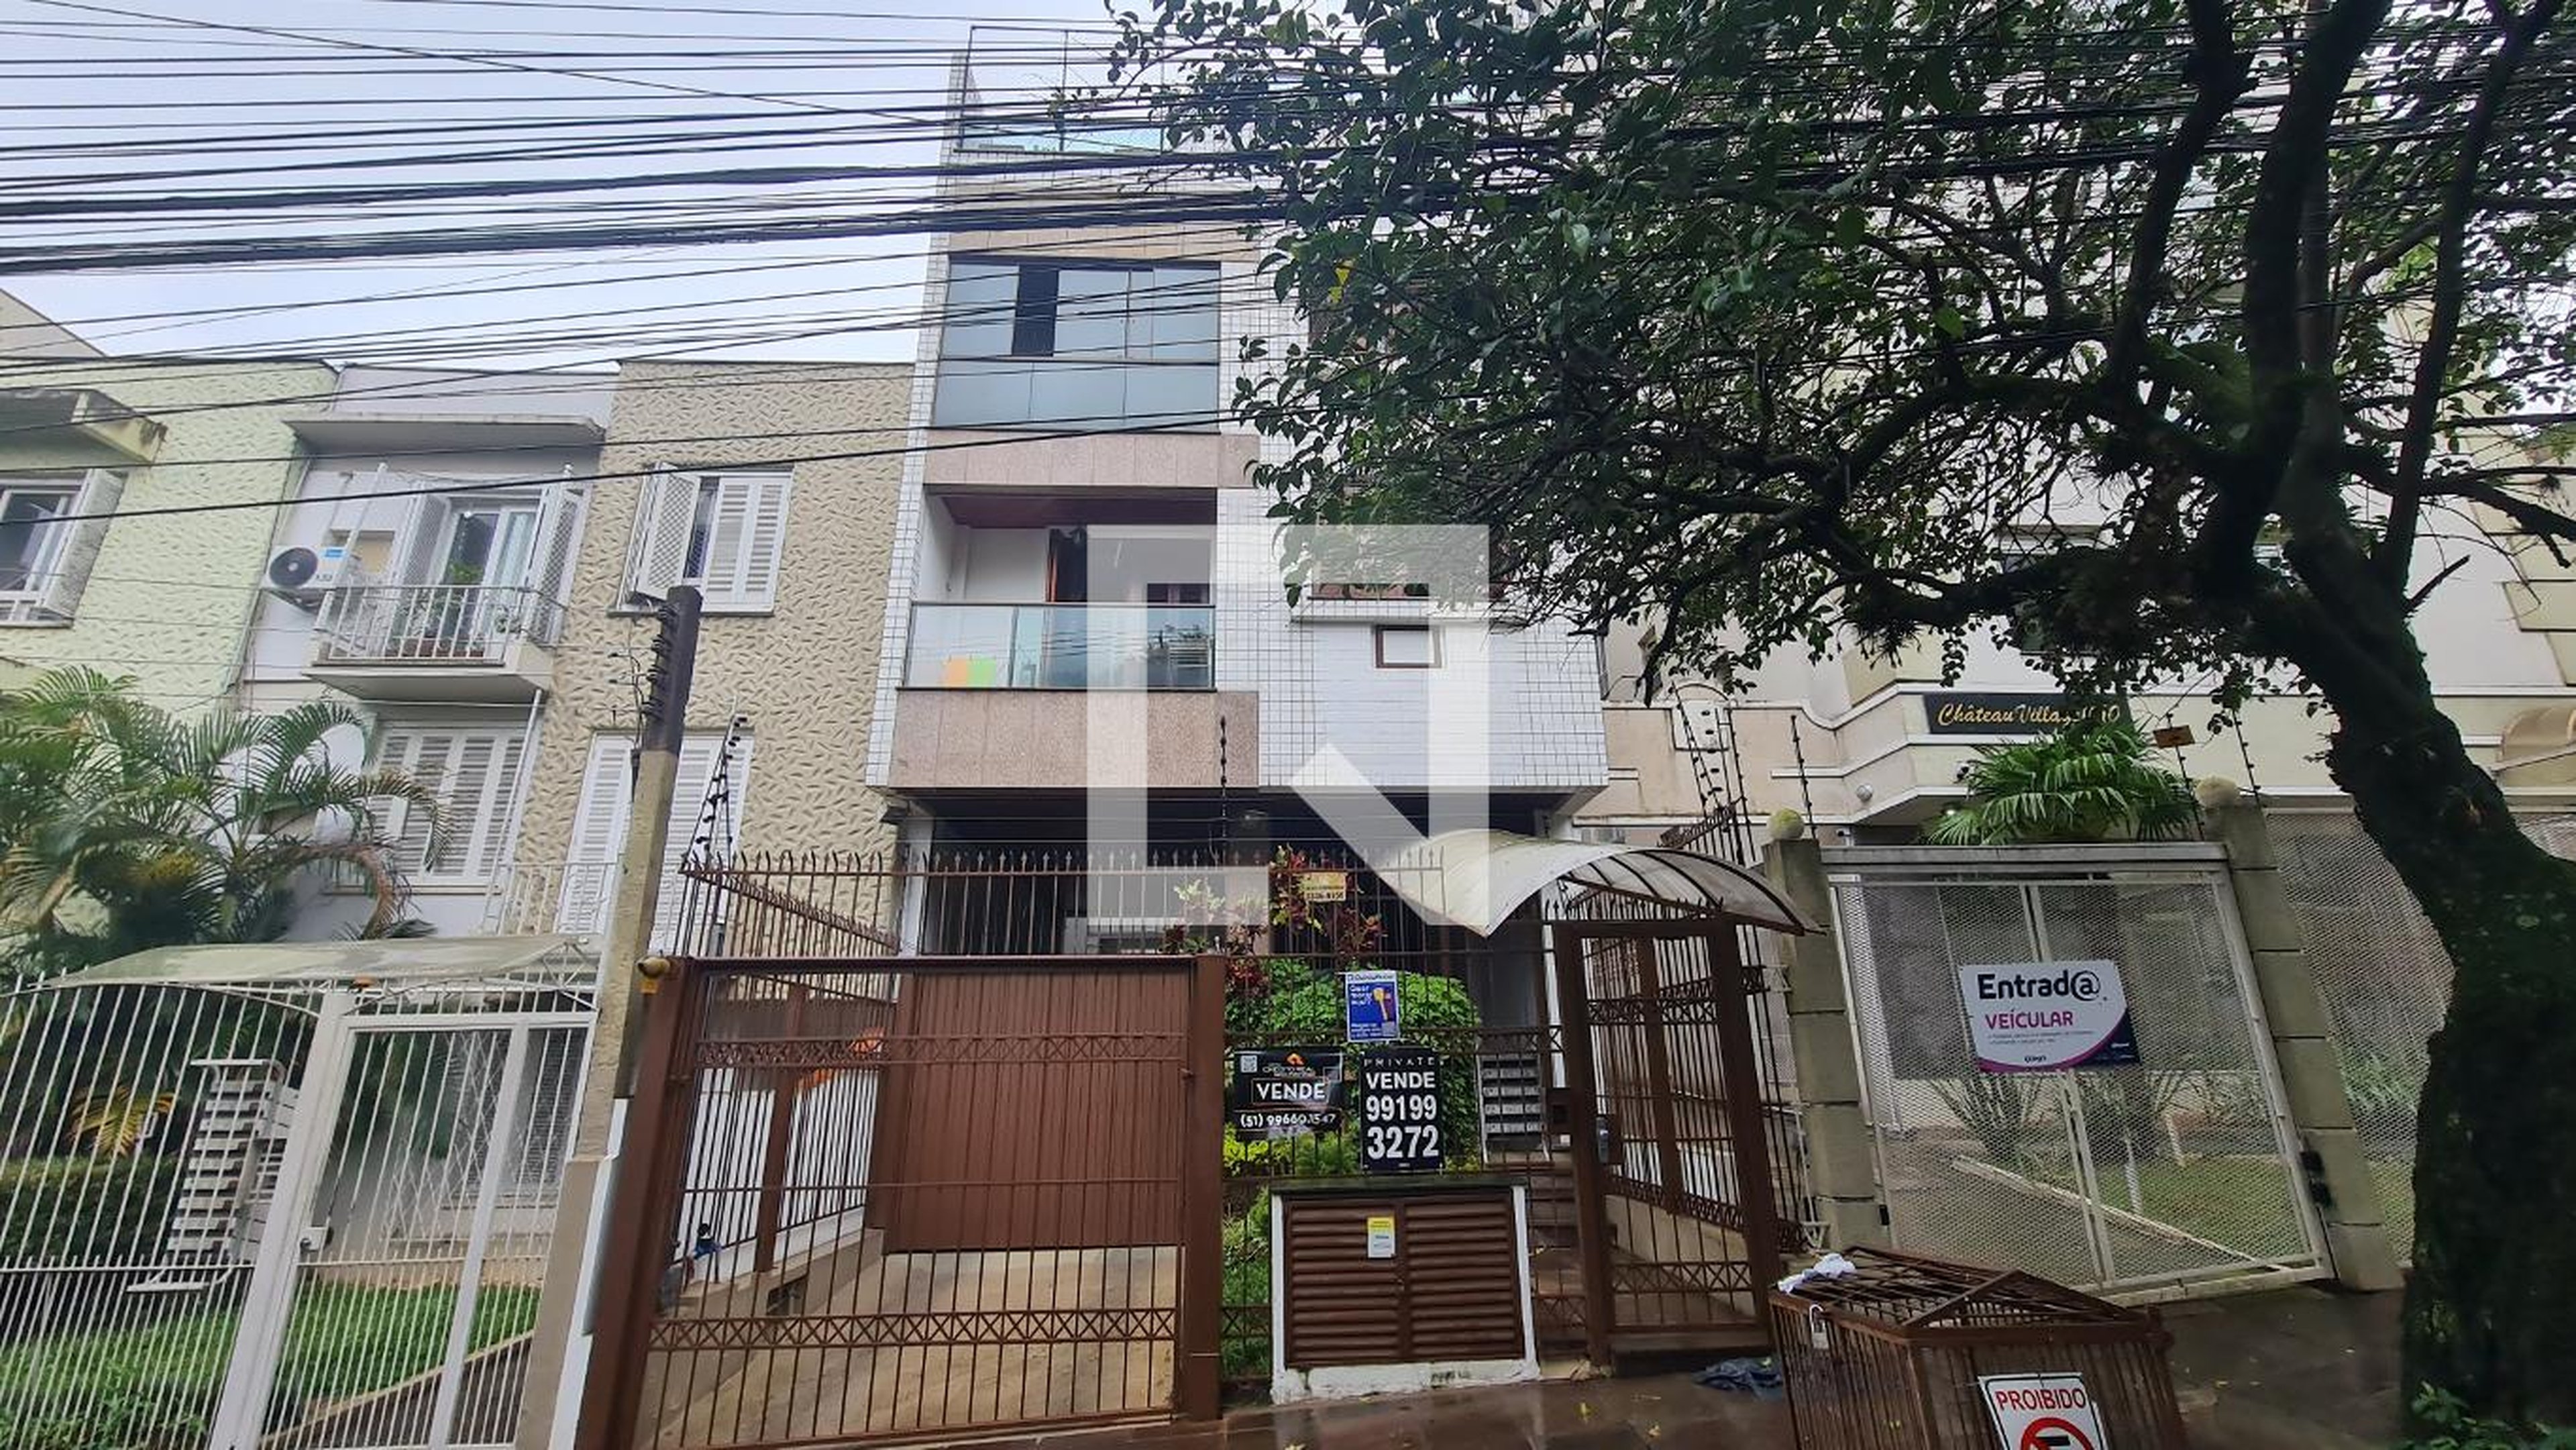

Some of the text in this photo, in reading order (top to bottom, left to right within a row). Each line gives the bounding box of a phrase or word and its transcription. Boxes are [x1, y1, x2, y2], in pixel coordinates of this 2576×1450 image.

[1937, 703, 2013, 725] Château
[1977, 970, 2100, 1001] Entrad@
[1985, 1008, 2074, 1029] VEÍCULAR
[1364, 1057, 1435, 1067] PRIVATE
[1256, 1082, 1326, 1100] VENDE
[1366, 1072, 1436, 1089] VENDE
[1366, 1094, 1437, 1121] 99199
[1240, 1113, 1263, 1128] (51)
[1367, 1125, 1440, 1159] 3272
[1995, 1388, 2086, 1410] PROIBIDO
